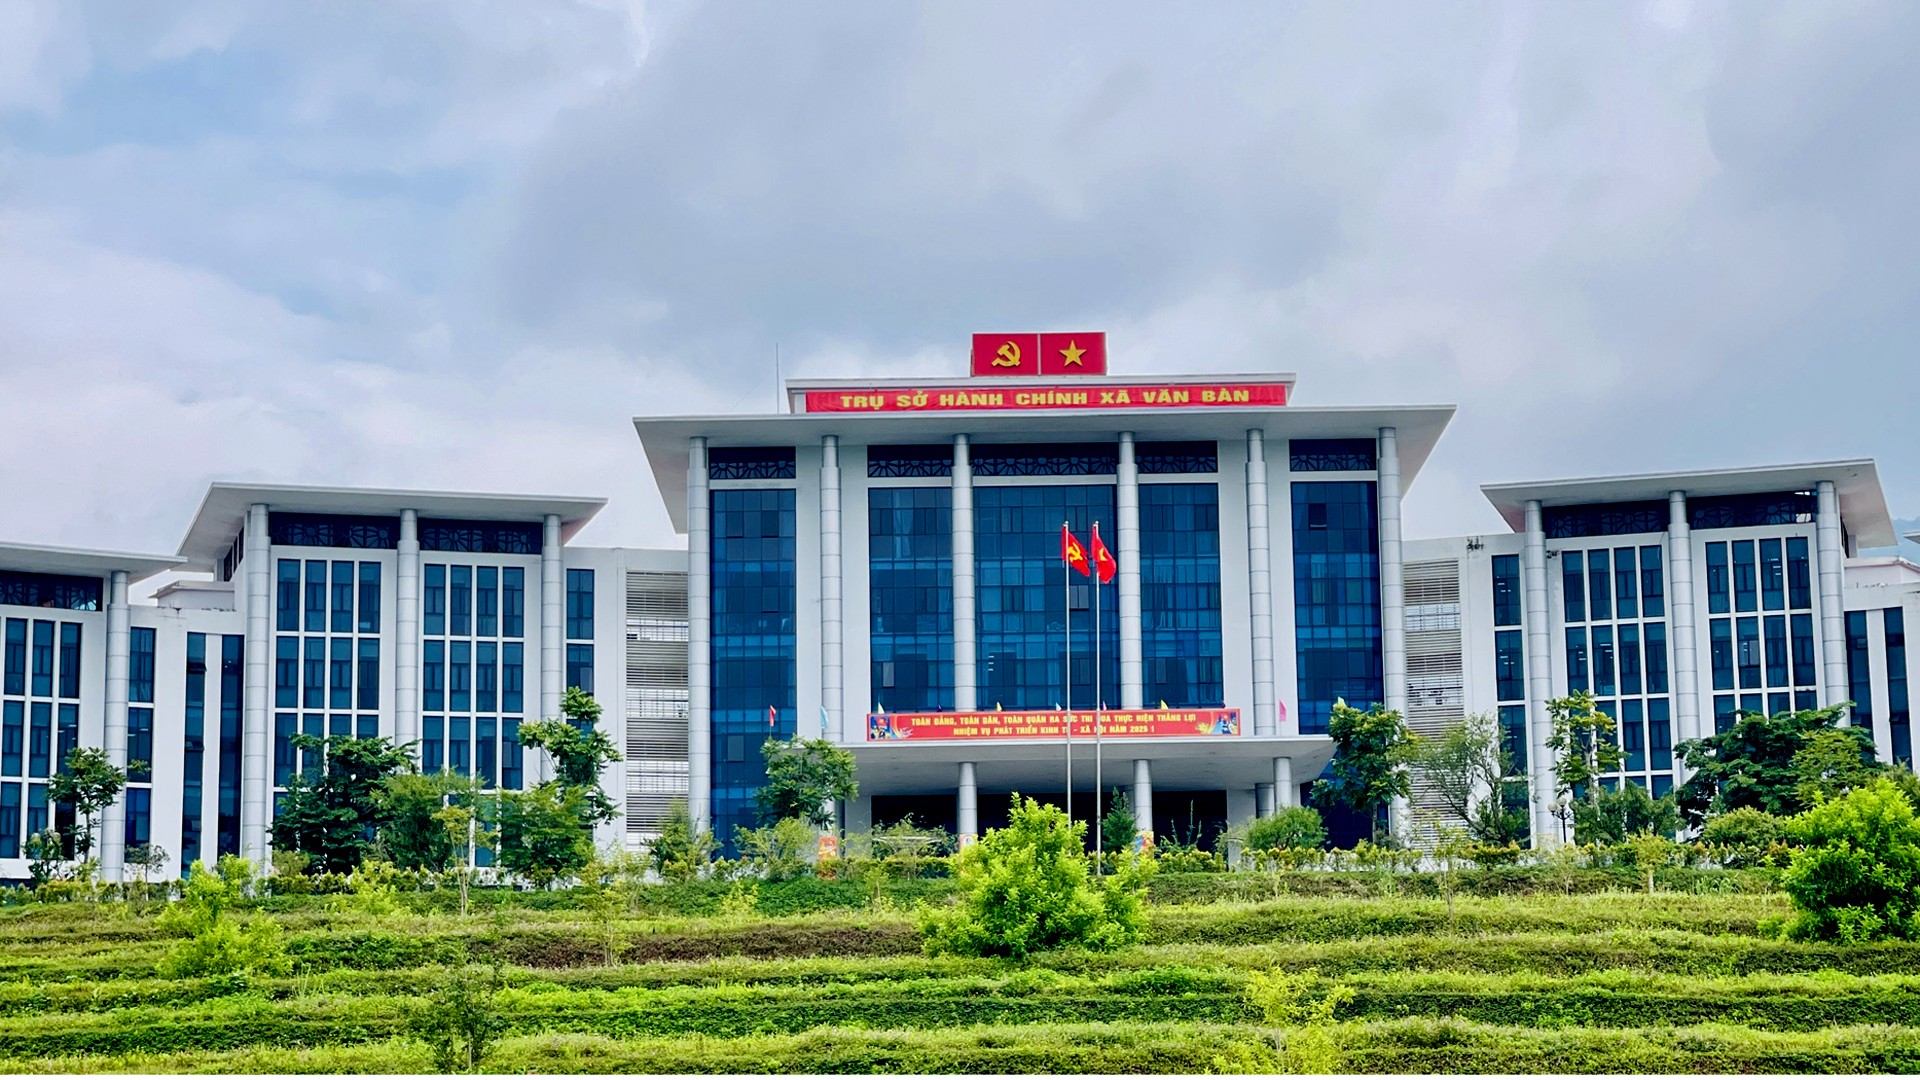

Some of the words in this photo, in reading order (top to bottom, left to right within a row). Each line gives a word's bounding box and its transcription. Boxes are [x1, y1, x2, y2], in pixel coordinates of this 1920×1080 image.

[840, 395, 884, 410] TRỤ
[897, 390, 928, 407] SỞ
[939, 391, 1003, 406] HÀNH
[1016, 391, 1087, 405] CHÍNH
[1101, 390, 1131, 404] XÃ
[1143, 389, 1189, 403] VĂN
[1202, 388, 1249, 402] BÀN
[912, 717, 930, 726] TOÀN
[960, 716, 979, 725] TOÀN
[1004, 715, 1023, 724] TOÀN
[1026, 714, 1046, 724] QUÂN
[1136, 714, 1154, 722] HIỆN
[954, 727, 978, 736] NHIỆM
